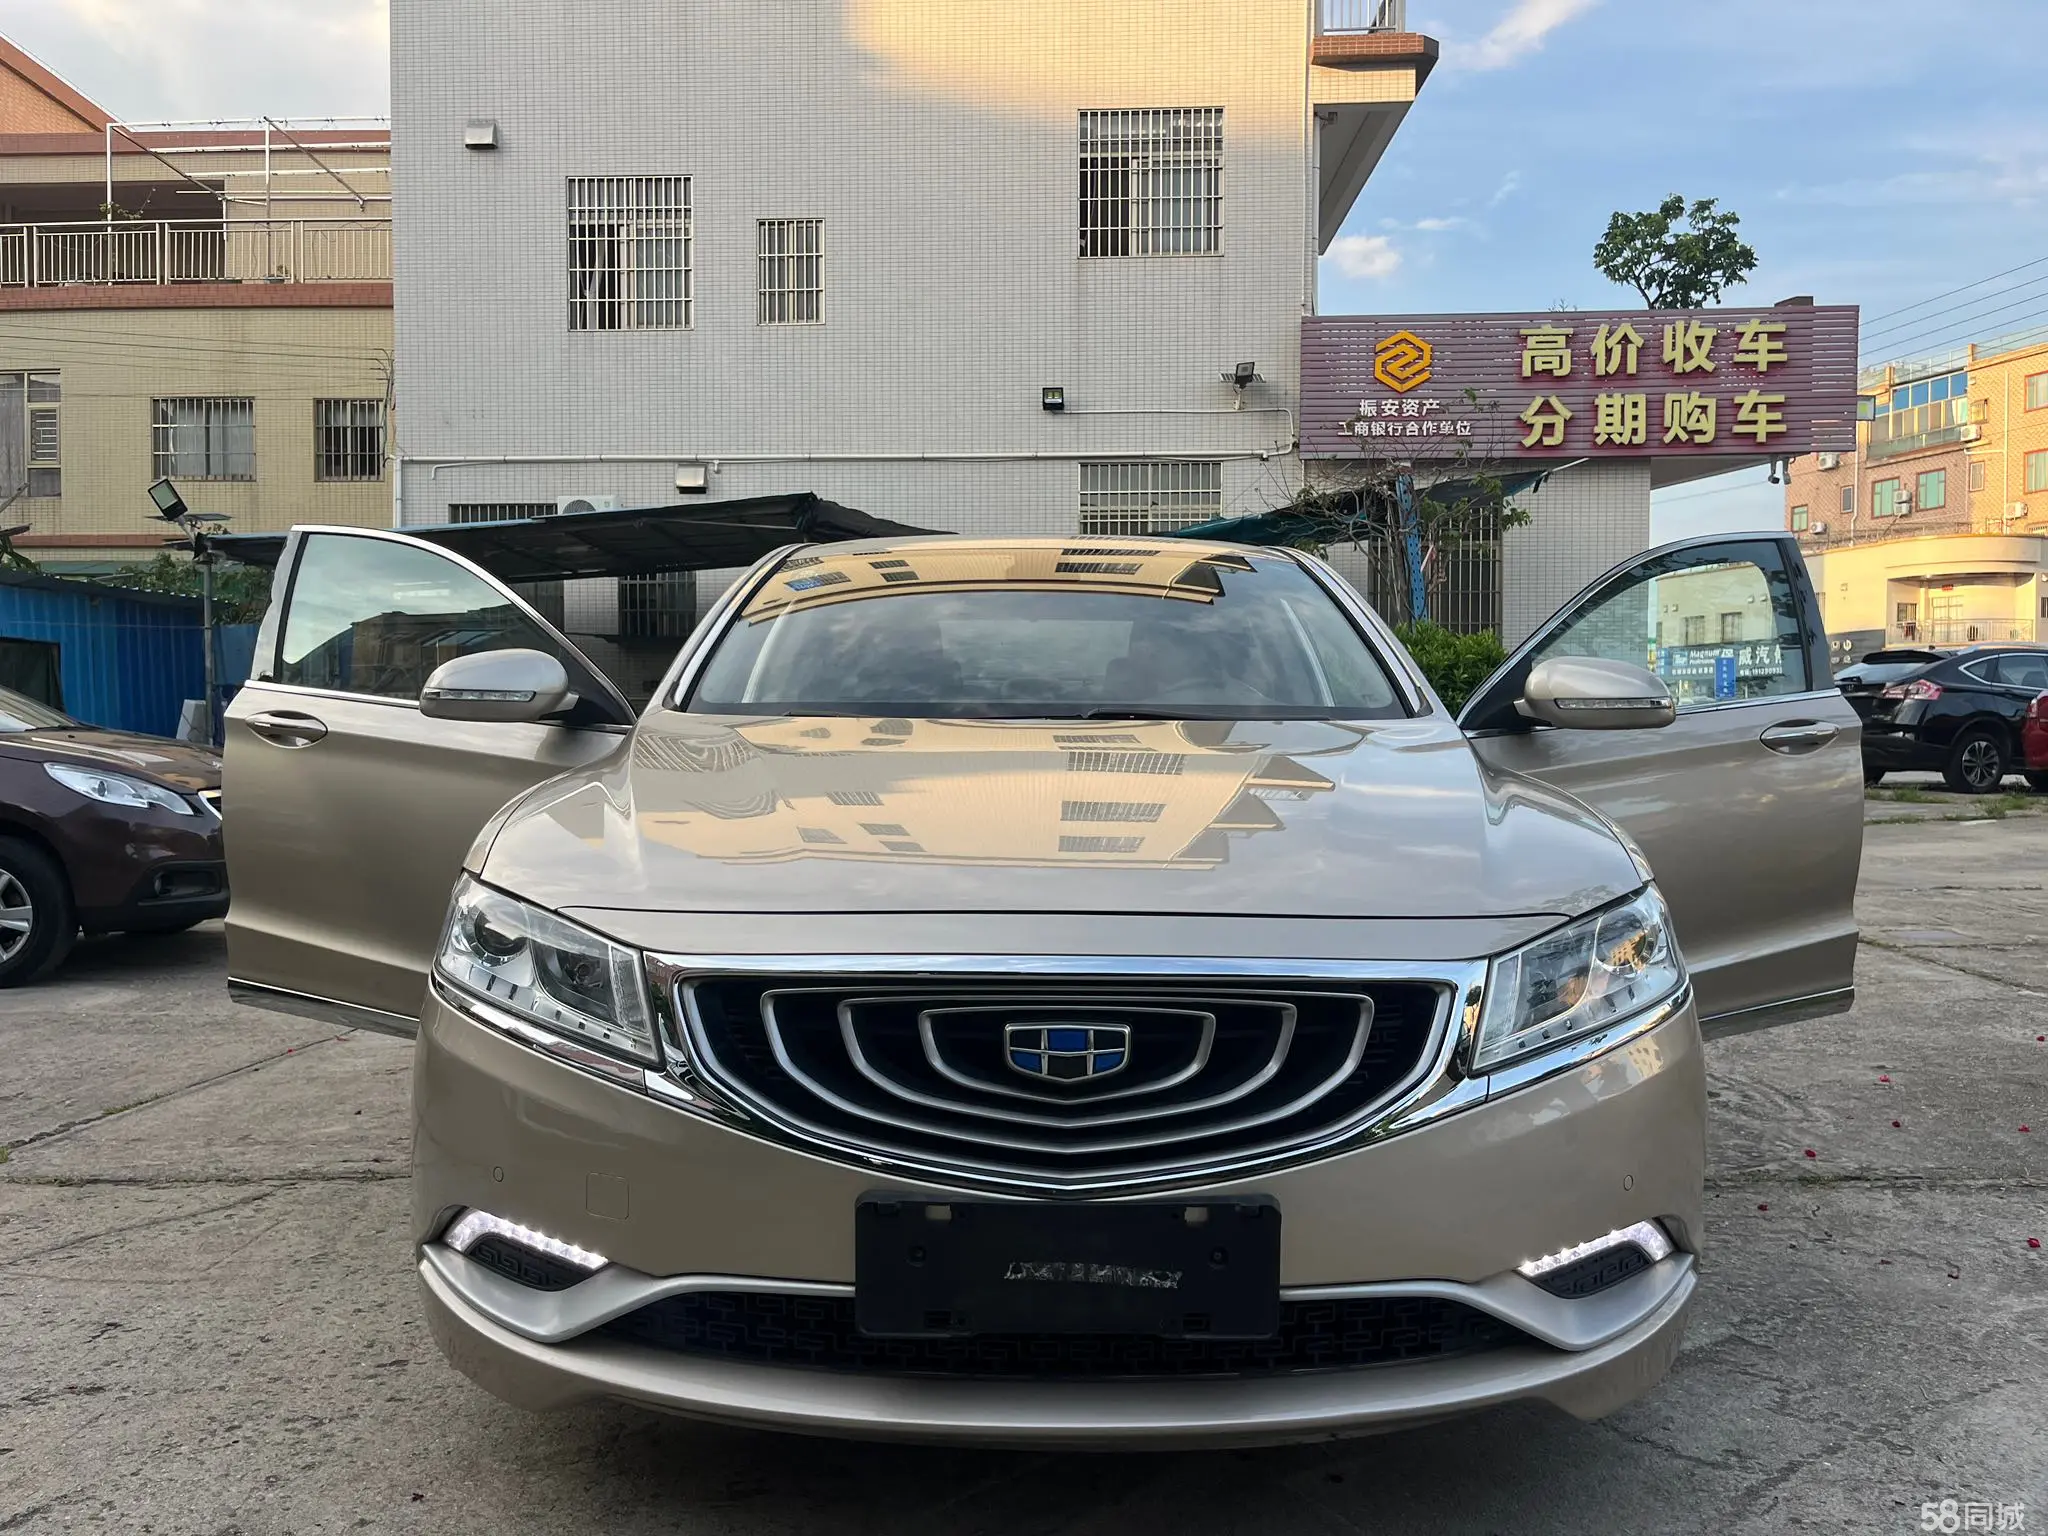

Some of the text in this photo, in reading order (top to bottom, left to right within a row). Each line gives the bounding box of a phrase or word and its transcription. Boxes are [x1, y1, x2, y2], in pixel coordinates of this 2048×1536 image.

[1519, 319, 1788, 377] 高价收车
[1359, 398, 1440, 417] 振安资产
[1519, 389, 1788, 448] 分期购车
[1337, 420, 1472, 437] 工商银行合作单位
